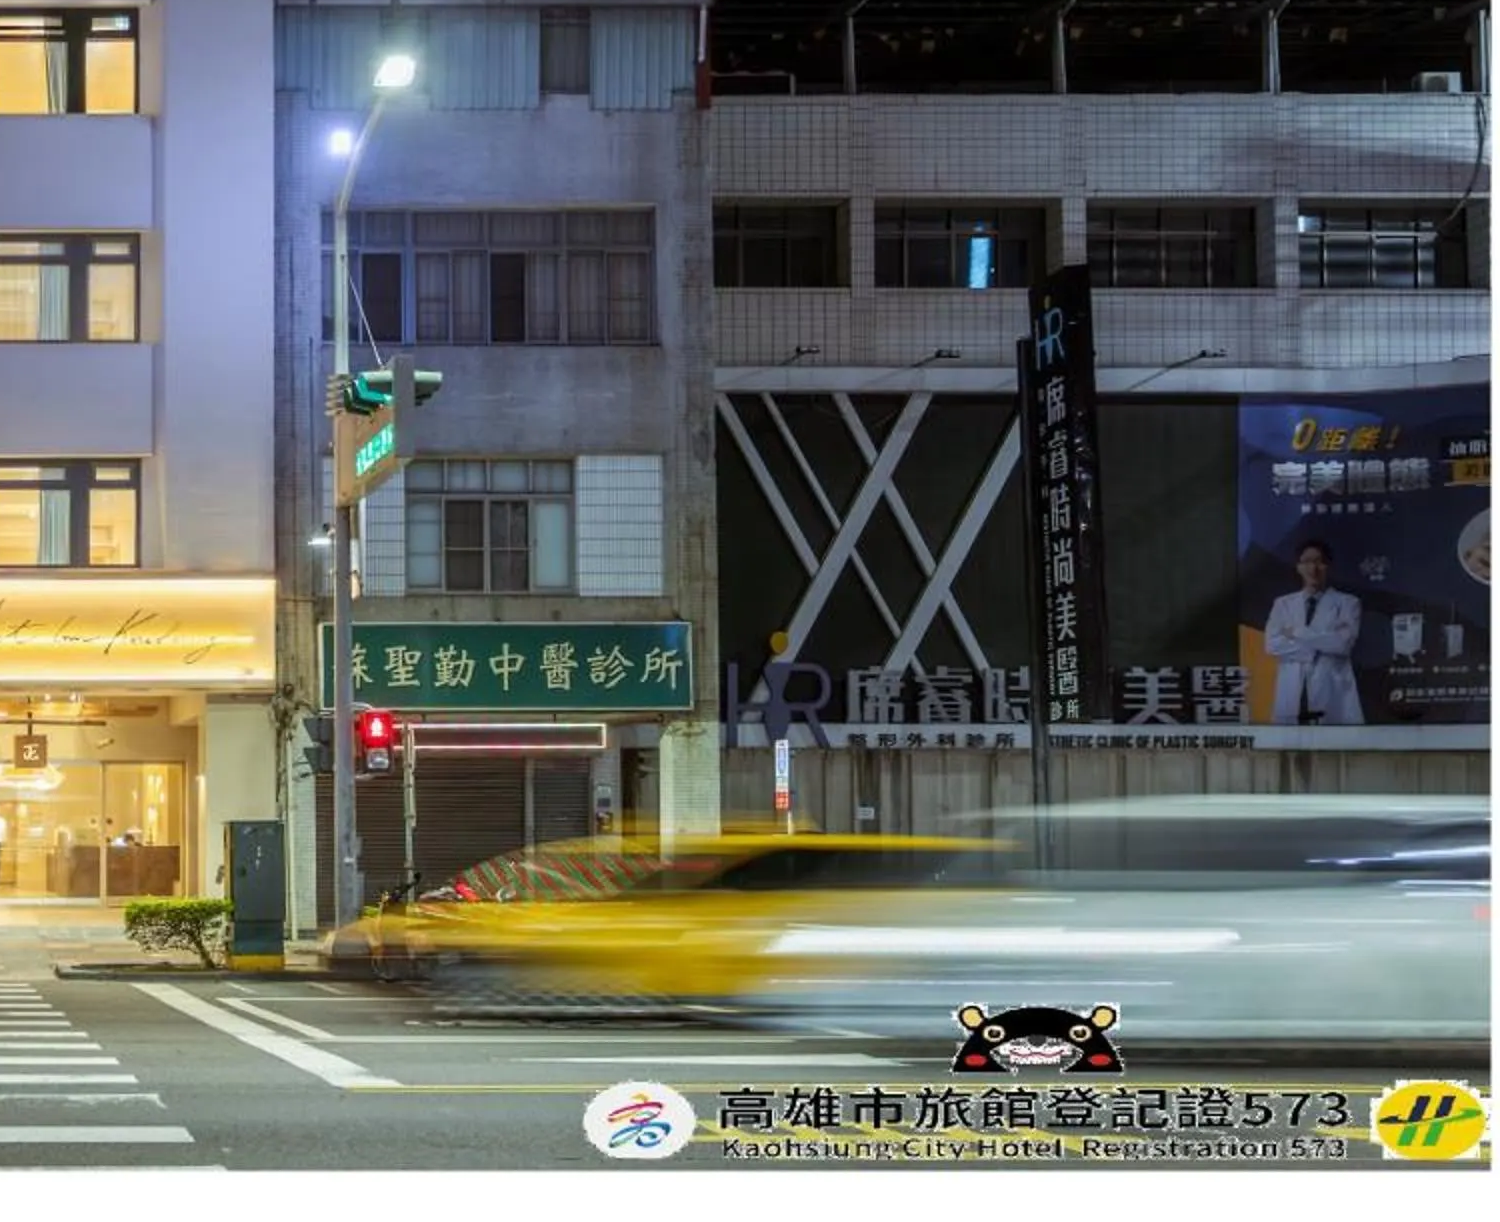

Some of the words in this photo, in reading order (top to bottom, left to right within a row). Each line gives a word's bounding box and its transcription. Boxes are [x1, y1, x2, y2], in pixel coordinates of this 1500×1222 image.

[847, 665, 1249, 724] 席睿時美醫
